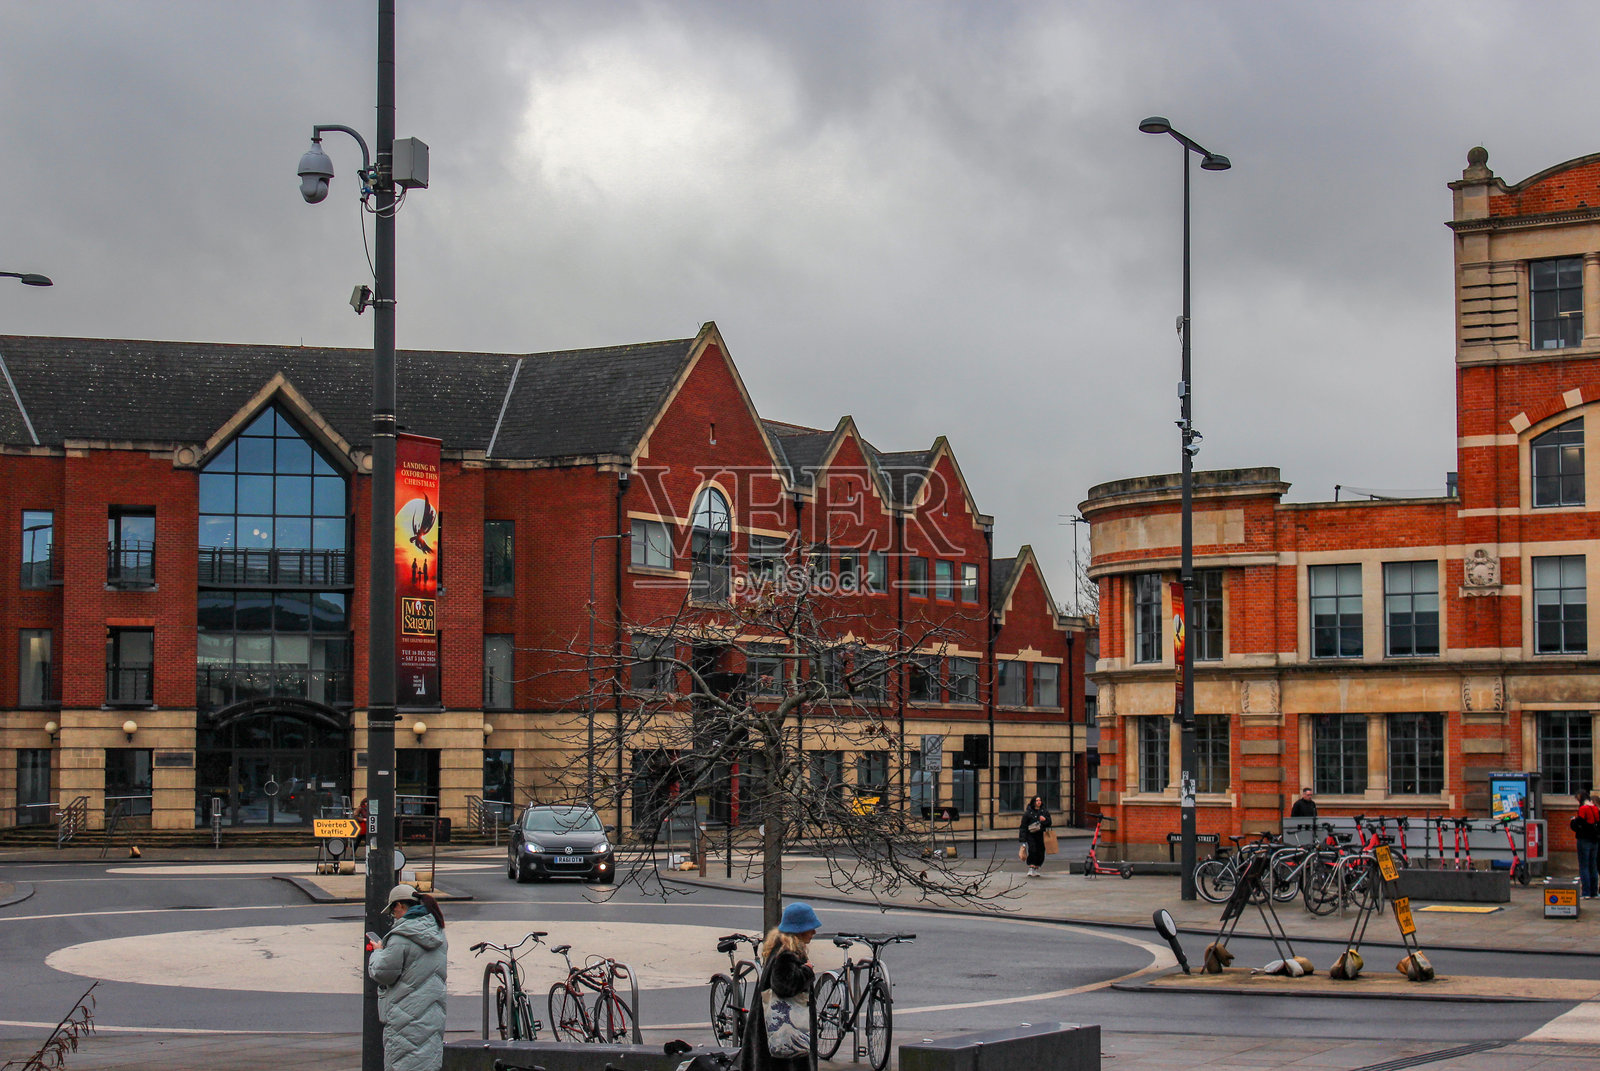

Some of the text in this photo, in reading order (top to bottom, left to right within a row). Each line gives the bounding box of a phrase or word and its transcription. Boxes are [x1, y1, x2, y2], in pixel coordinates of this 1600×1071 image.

[403, 462, 428, 471] LANDING
[402, 470, 438, 480] OXFORD THIS
[404, 478, 436, 488] CHRISTMAS
[404, 614, 434, 634] Saigon
